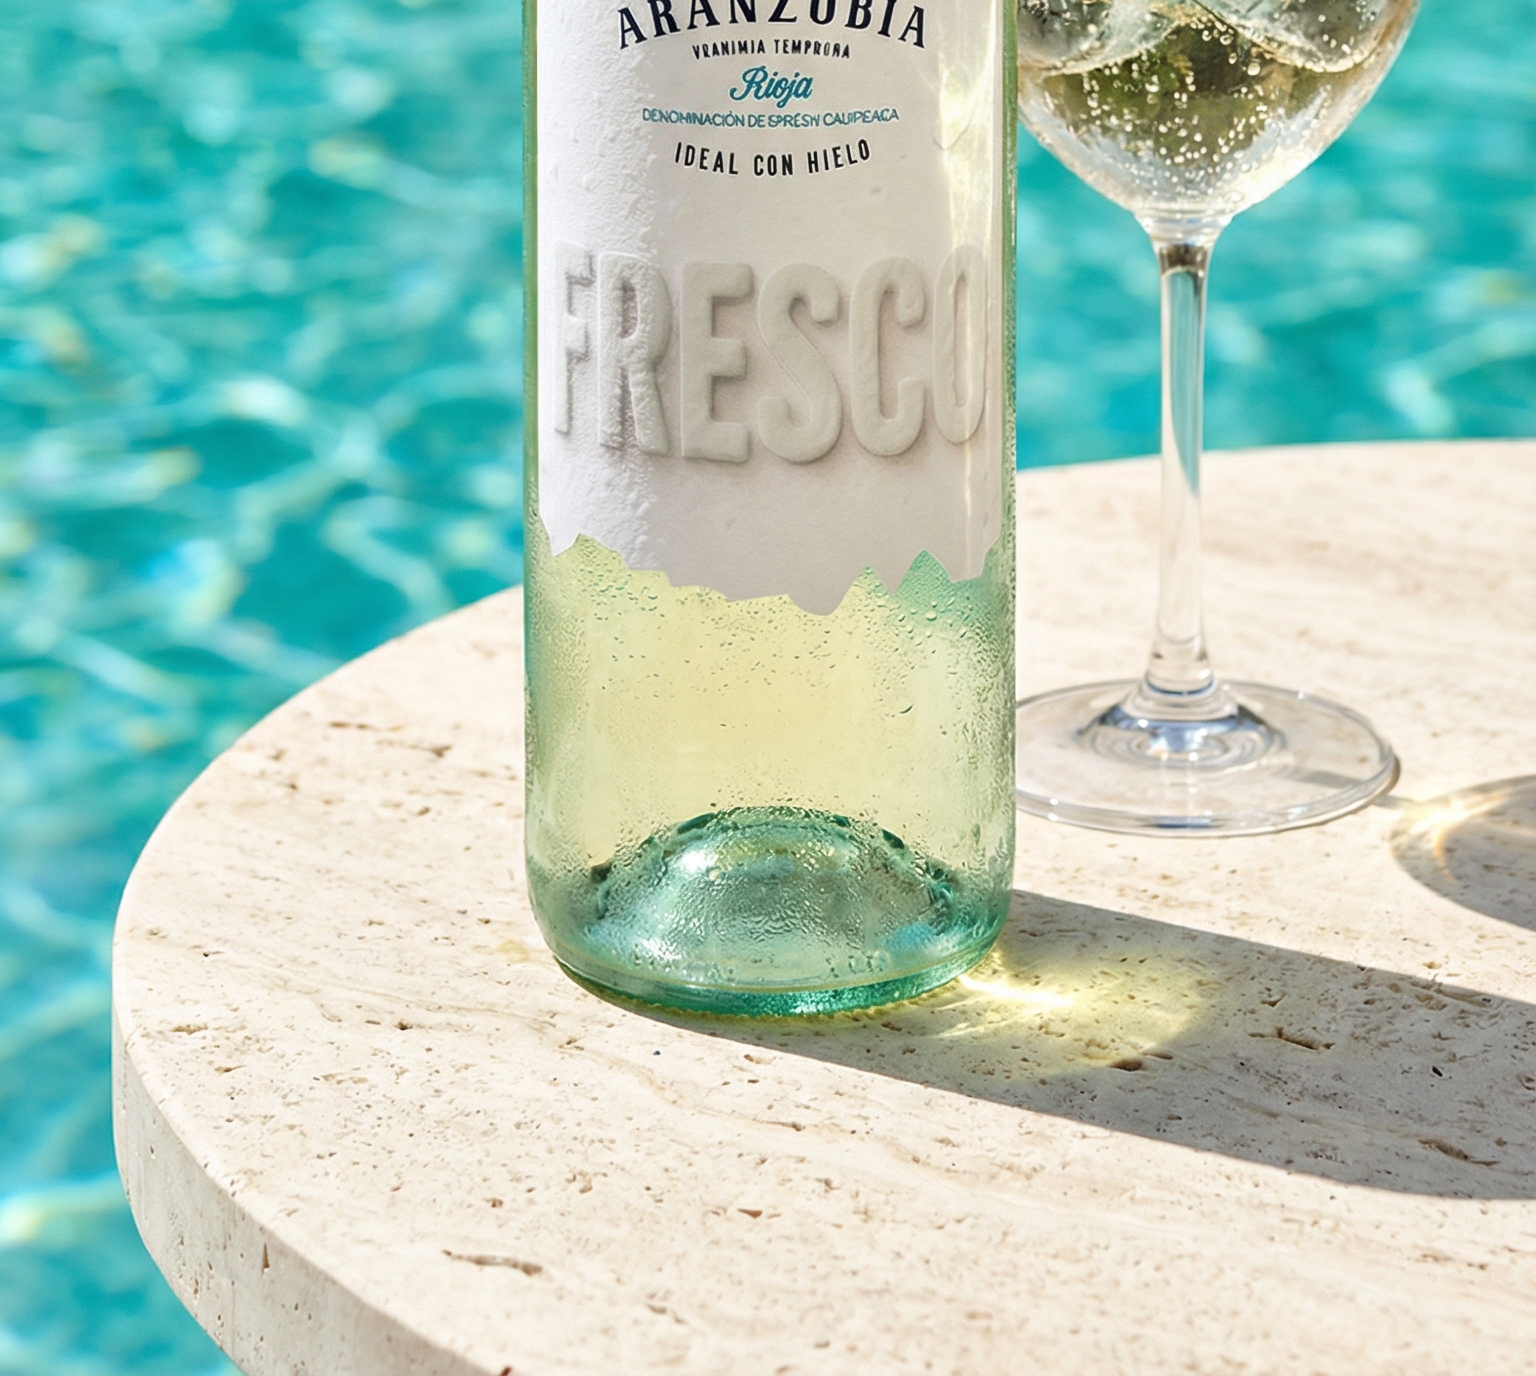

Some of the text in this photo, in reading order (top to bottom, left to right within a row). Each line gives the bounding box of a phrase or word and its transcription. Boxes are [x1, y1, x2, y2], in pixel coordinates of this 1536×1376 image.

[729, 65, 814, 109] Rioja
[747, 114, 766, 128] DE
[674, 138, 871, 176] IDEAL CON HIELO
[554, 240, 988, 464] FRESCO
